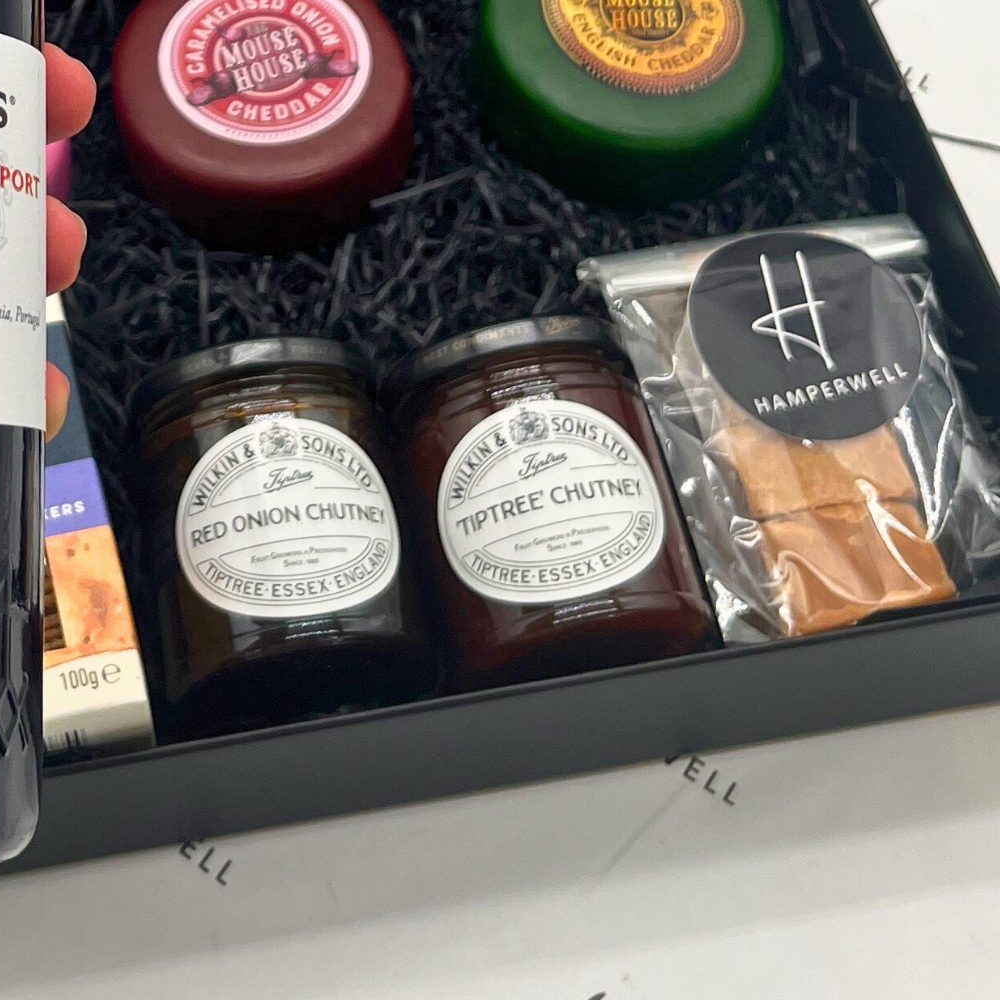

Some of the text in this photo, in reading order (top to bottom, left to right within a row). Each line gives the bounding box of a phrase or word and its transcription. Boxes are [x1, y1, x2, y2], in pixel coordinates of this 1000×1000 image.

[290, 1, 340, 47] ONION
[611, 7, 678, 31] HOUSE
[220, 26, 298, 69] MOUSE
[231, 48, 306, 92] HOUSE
[226, 82, 333, 122] CHEDDAR
[0, 165, 41, 199] PORT
[753, 362, 910, 416] HAMPERWELL
[193, 434, 374, 508] WILKIN & SONS LTD
[450, 416, 631, 500] WILKIN & SONS LTD
[550, 477, 642, 505] CHUTNEY
[191, 502, 386, 548] RED ONION CHUTNEY
[204, 561, 268, 597] TIPTREE
[271, 580, 331, 598] ESSEX
[333, 540, 387, 589] ENGLAND
[470, 553, 532, 585] TIPTREE
[538, 562, 597, 584] ESSEX
[600, 514, 652, 570] ENGLAND
[58, 667, 100, 691] 100g
